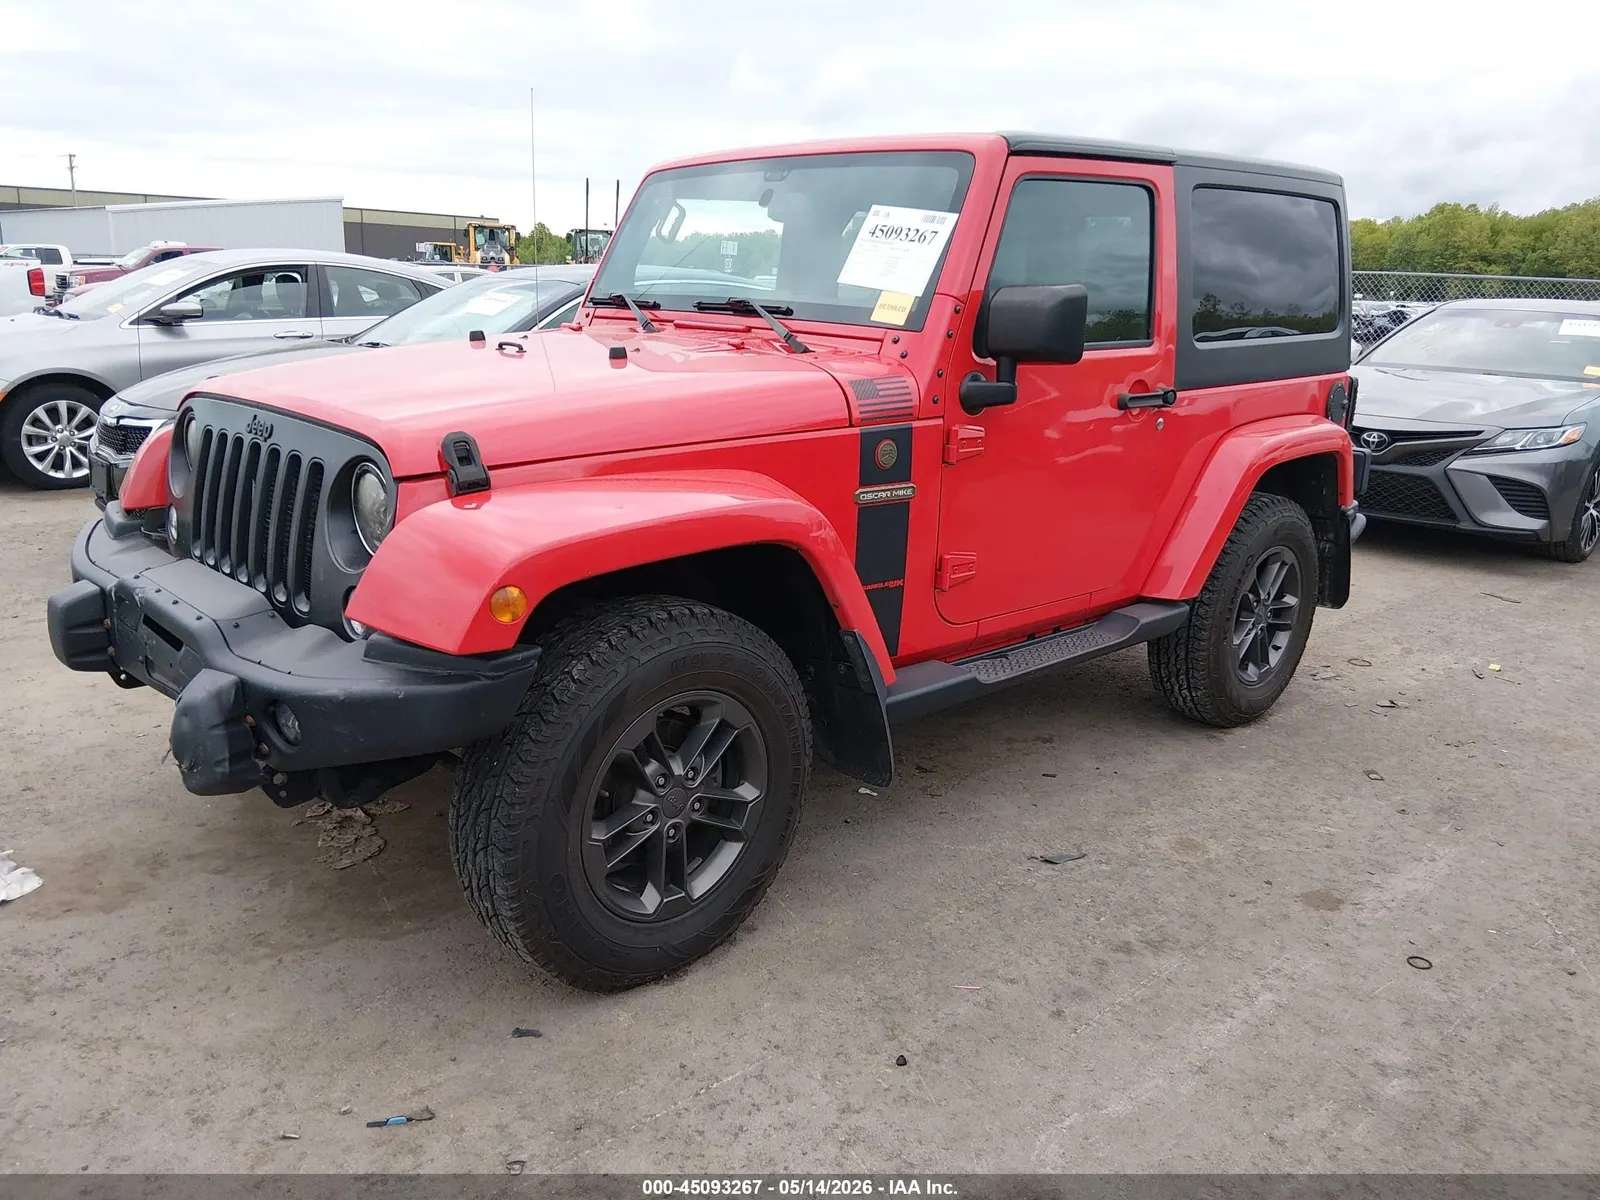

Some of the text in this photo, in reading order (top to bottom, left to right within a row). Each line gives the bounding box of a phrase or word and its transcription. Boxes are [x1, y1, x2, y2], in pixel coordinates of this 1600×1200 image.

[868, 223, 939, 246] 45093267
[245, 414, 274, 442] Jeep
[860, 488, 913, 500] OSCAR MIKE
